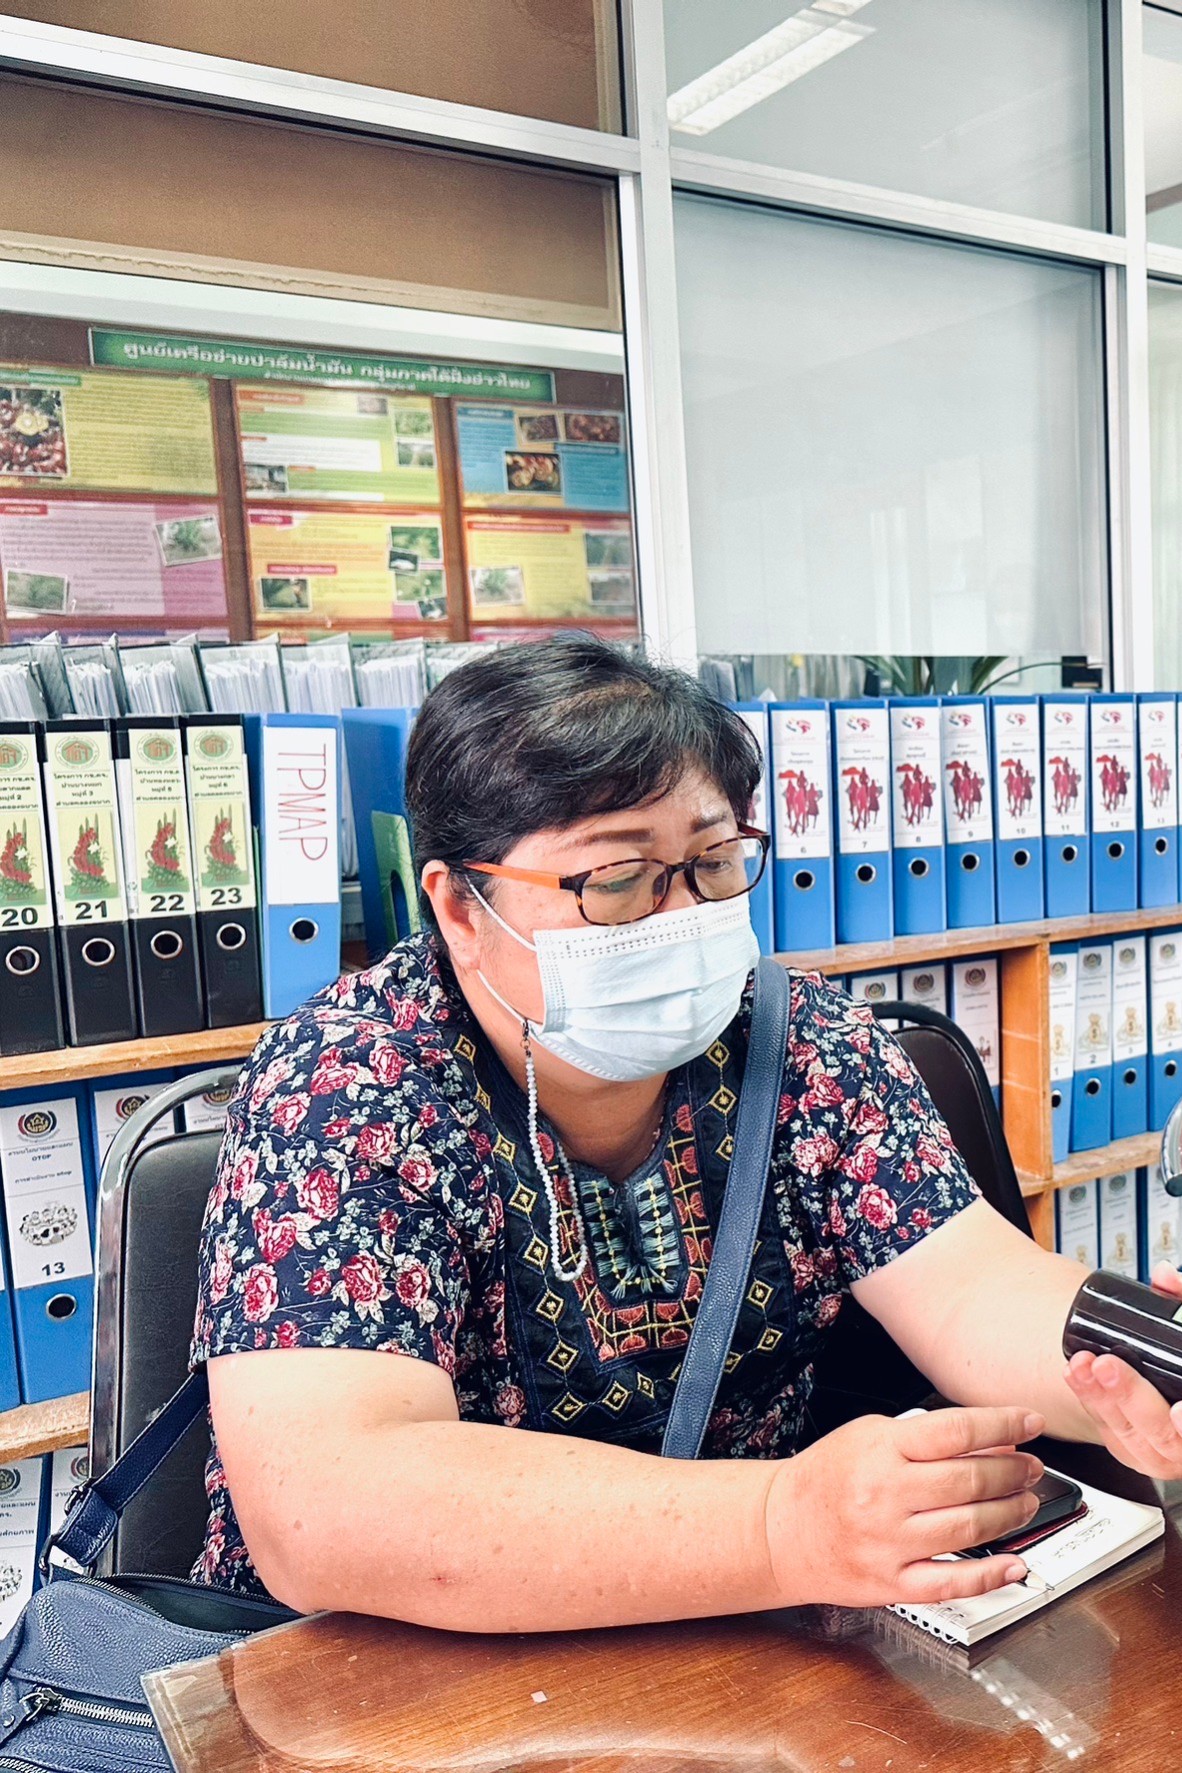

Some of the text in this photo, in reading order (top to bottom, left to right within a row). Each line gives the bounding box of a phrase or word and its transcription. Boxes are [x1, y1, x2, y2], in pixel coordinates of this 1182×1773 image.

[277, 743, 328, 861] TPMAP
[150, 894, 185, 912] 22
[210, 887, 243, 906] 23
[1, 907, 38, 927] 20
[75, 900, 108, 920] 21
[1090, 1055, 1097, 1063] 2
[41, 1262, 65, 1277] 13
